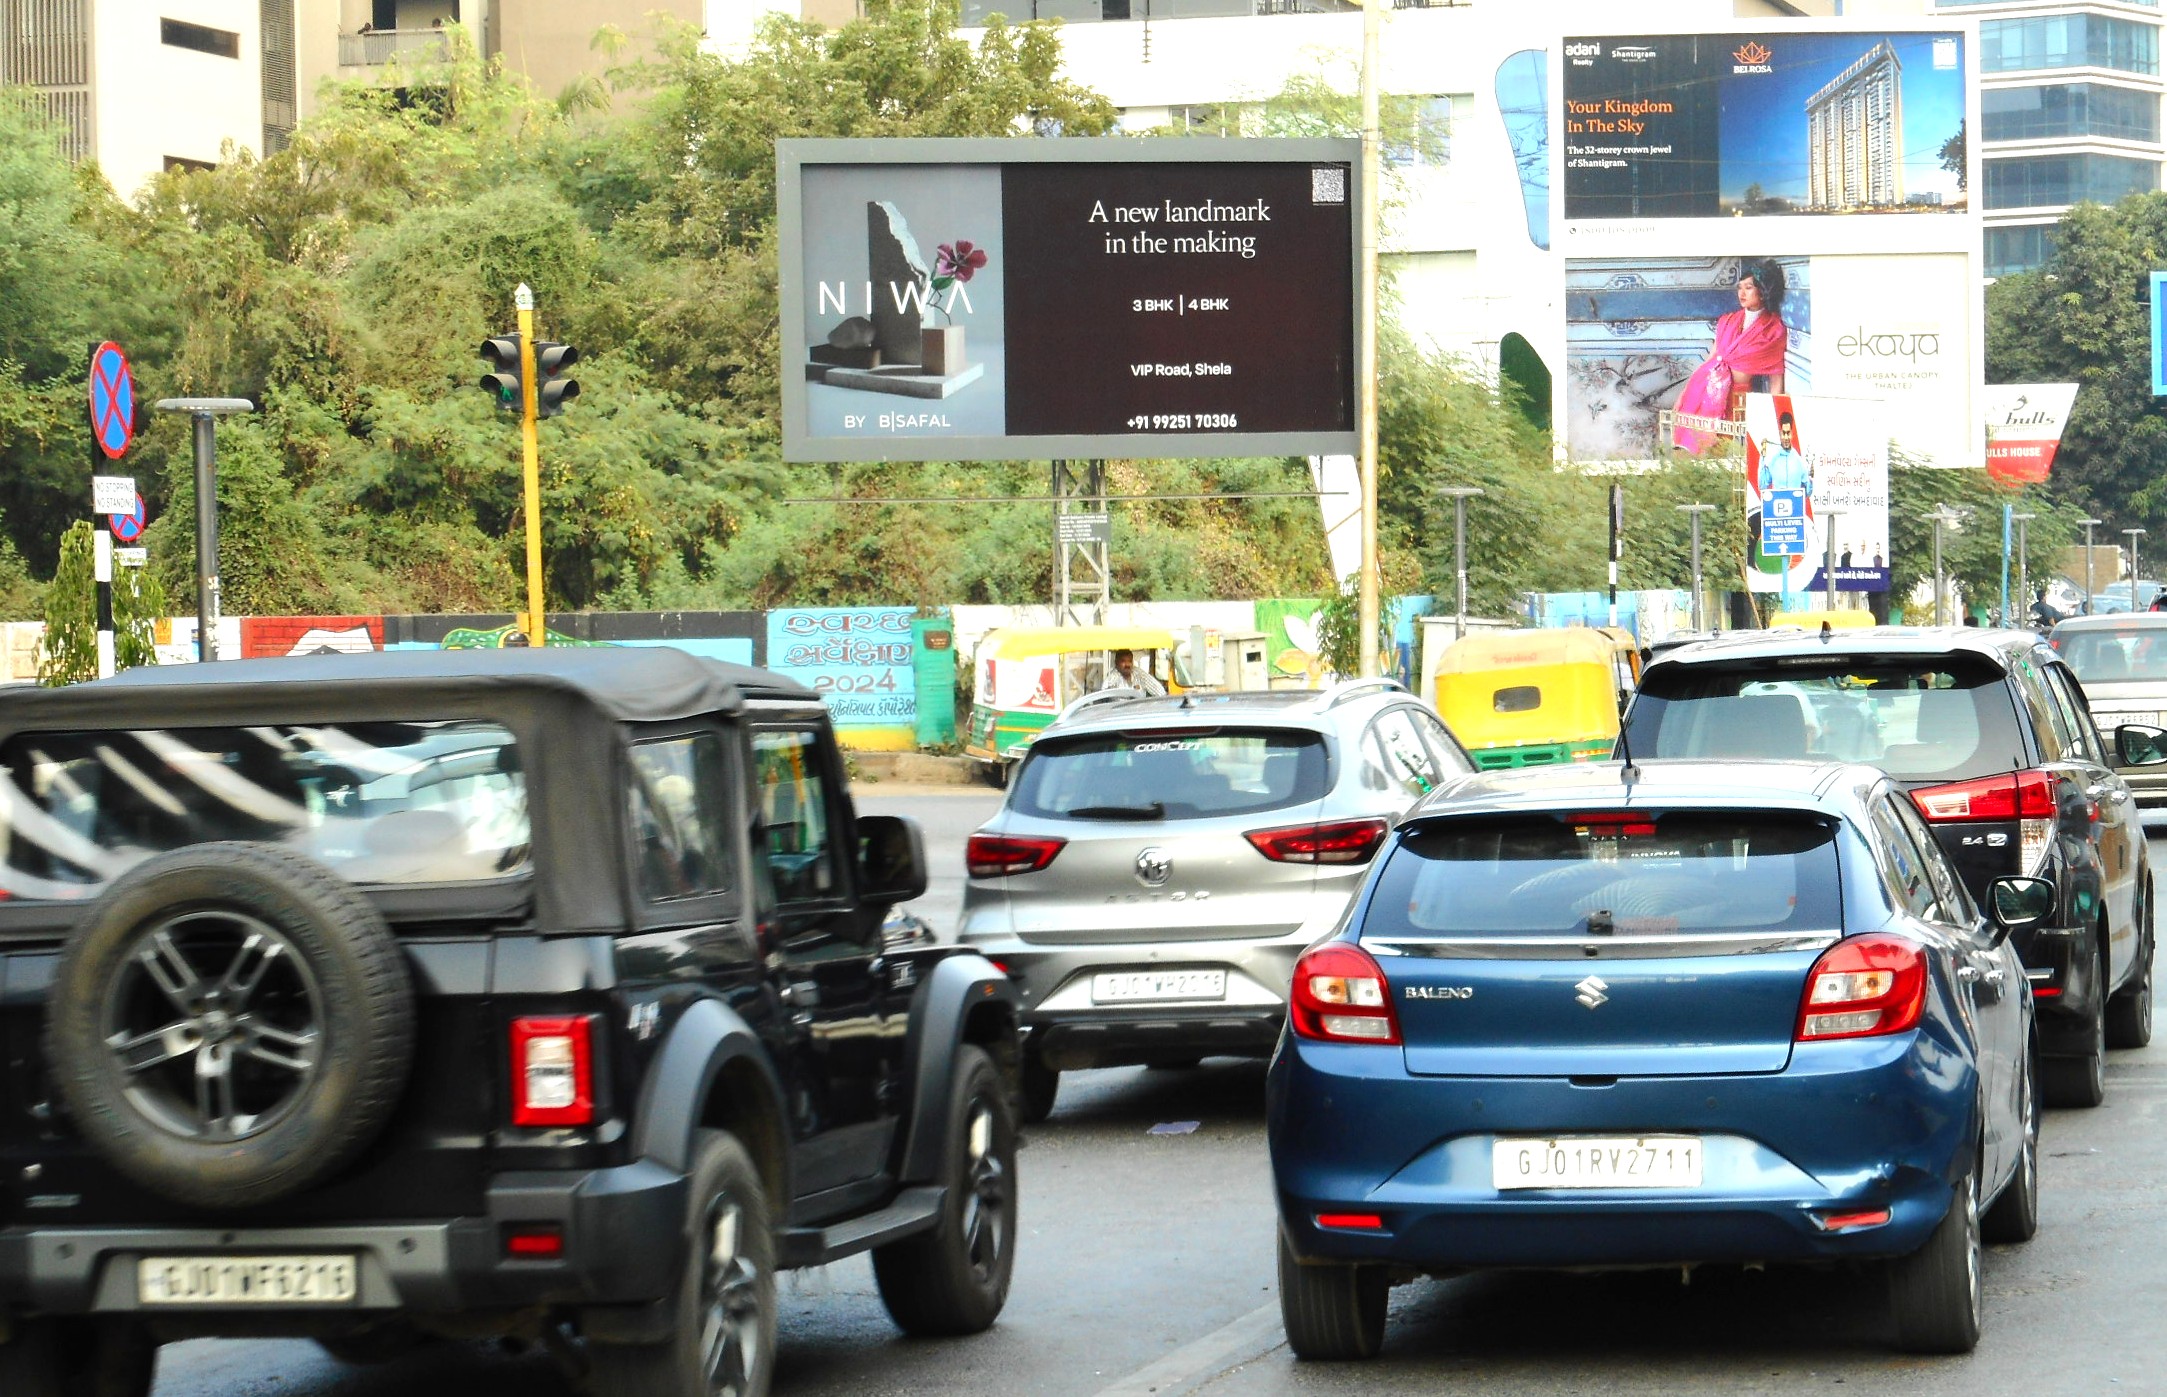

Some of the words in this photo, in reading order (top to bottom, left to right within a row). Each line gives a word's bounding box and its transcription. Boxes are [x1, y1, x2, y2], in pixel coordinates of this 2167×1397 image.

[1566, 43, 1600, 56] adani
[1612, 50, 1656, 59] Shantigram
[1573, 58, 1593, 66] Realty
[1733, 65, 1773, 73] BELROSA
[1567, 100, 1602, 113] Your
[1605, 99, 1673, 117] Kingdom
[1567, 119, 1583, 133] In
[1586, 119, 1615, 133] The
[1617, 119, 1645, 135] Sky
[1567, 146, 1584, 155] The
[1585, 146, 1622, 155] 32-storey
[1650, 145, 1672, 155] jewel
[1567, 159, 1577, 168] of
[1577, 159, 1628, 168] Shantigram.
[1088, 199, 1109, 223] A
[1114, 206, 1159, 223] new
[1165, 198, 1271, 222] landmark
[1105, 231, 1126, 254] in
[1132, 230, 1168, 254] the
[1173, 229, 1257, 259] making
[1132, 299, 1143, 312] 3
[1145, 299, 1174, 312] BHK
[1188, 298, 1198, 311] 4
[1200, 298, 1229, 311] BHK
[1837, 325, 1940, 364] ekaya
[1130, 364, 1153, 376] VIP
[1155, 363, 1192, 378] Road,
[1194, 362, 1232, 376] Shela
[844, 415, 866, 428] BY
[1127, 415, 1149, 429] +91
[1152, 414, 1191, 429] 99251
[1195, 413, 1238, 428] 70306
[2005, 411, 2056, 425] bulls
[1986, 448, 2008, 458] ULLS
[2010, 447, 2041, 457] HOUSE
[96, 482, 104, 493] NO
[106, 482, 134, 493] STOPPING
[97, 498, 105, 509] NO
[106, 498, 134, 509] STANDING
[814, 668, 897, 693] 2024
[1134, 741, 1204, 752] CONCEPT
[1406, 986, 1473, 999] BALENO
[1518, 1148, 1694, 1176] GJ01RV2711
